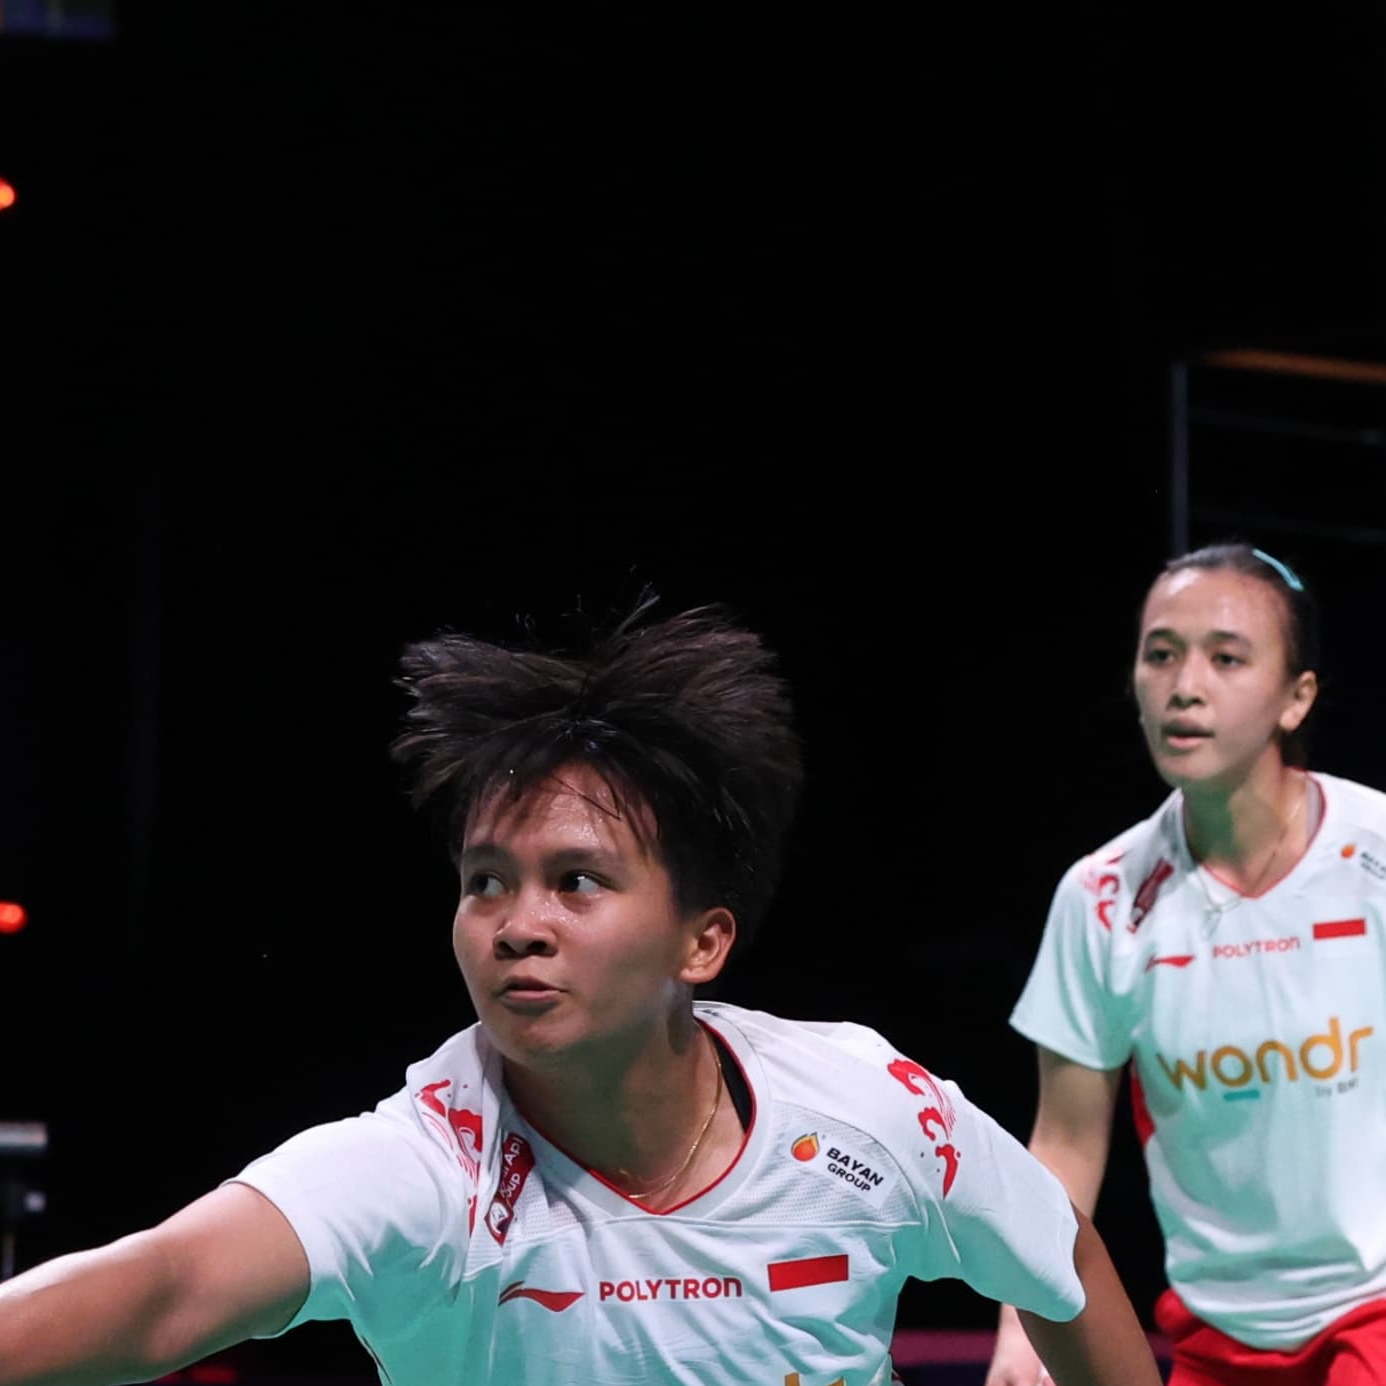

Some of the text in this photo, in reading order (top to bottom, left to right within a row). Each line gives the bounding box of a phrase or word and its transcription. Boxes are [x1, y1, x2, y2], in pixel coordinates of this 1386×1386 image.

[1156, 1017, 1374, 1090] wondr
[826, 1147, 885, 1186] BAYAN
[827, 1163, 872, 1192] GROUP
